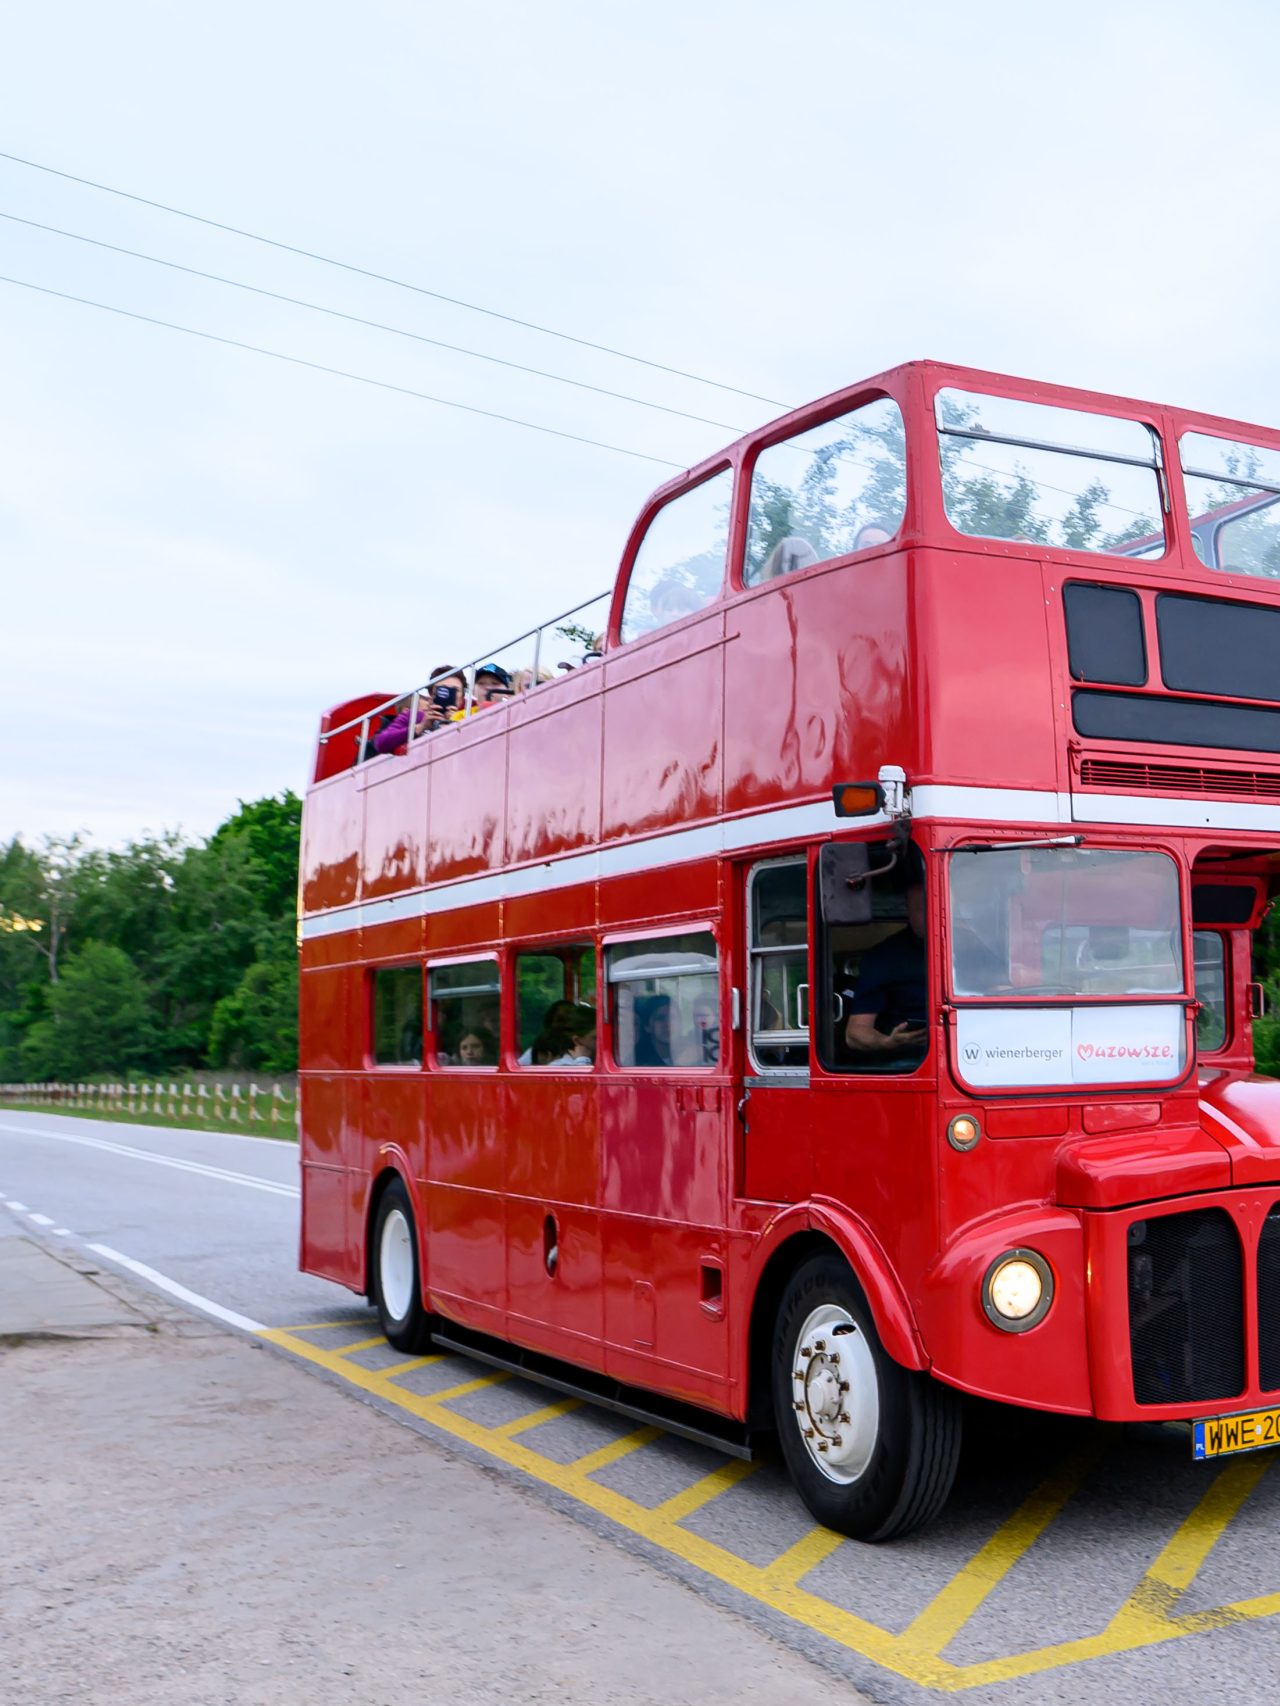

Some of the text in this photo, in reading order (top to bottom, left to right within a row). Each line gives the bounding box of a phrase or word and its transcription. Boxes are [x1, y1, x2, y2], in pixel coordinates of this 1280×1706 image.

[985, 1046, 1064, 1062] wienerberger
[1209, 1419, 1254, 1451] WWE
[1195, 1443, 1205, 1452] PL
